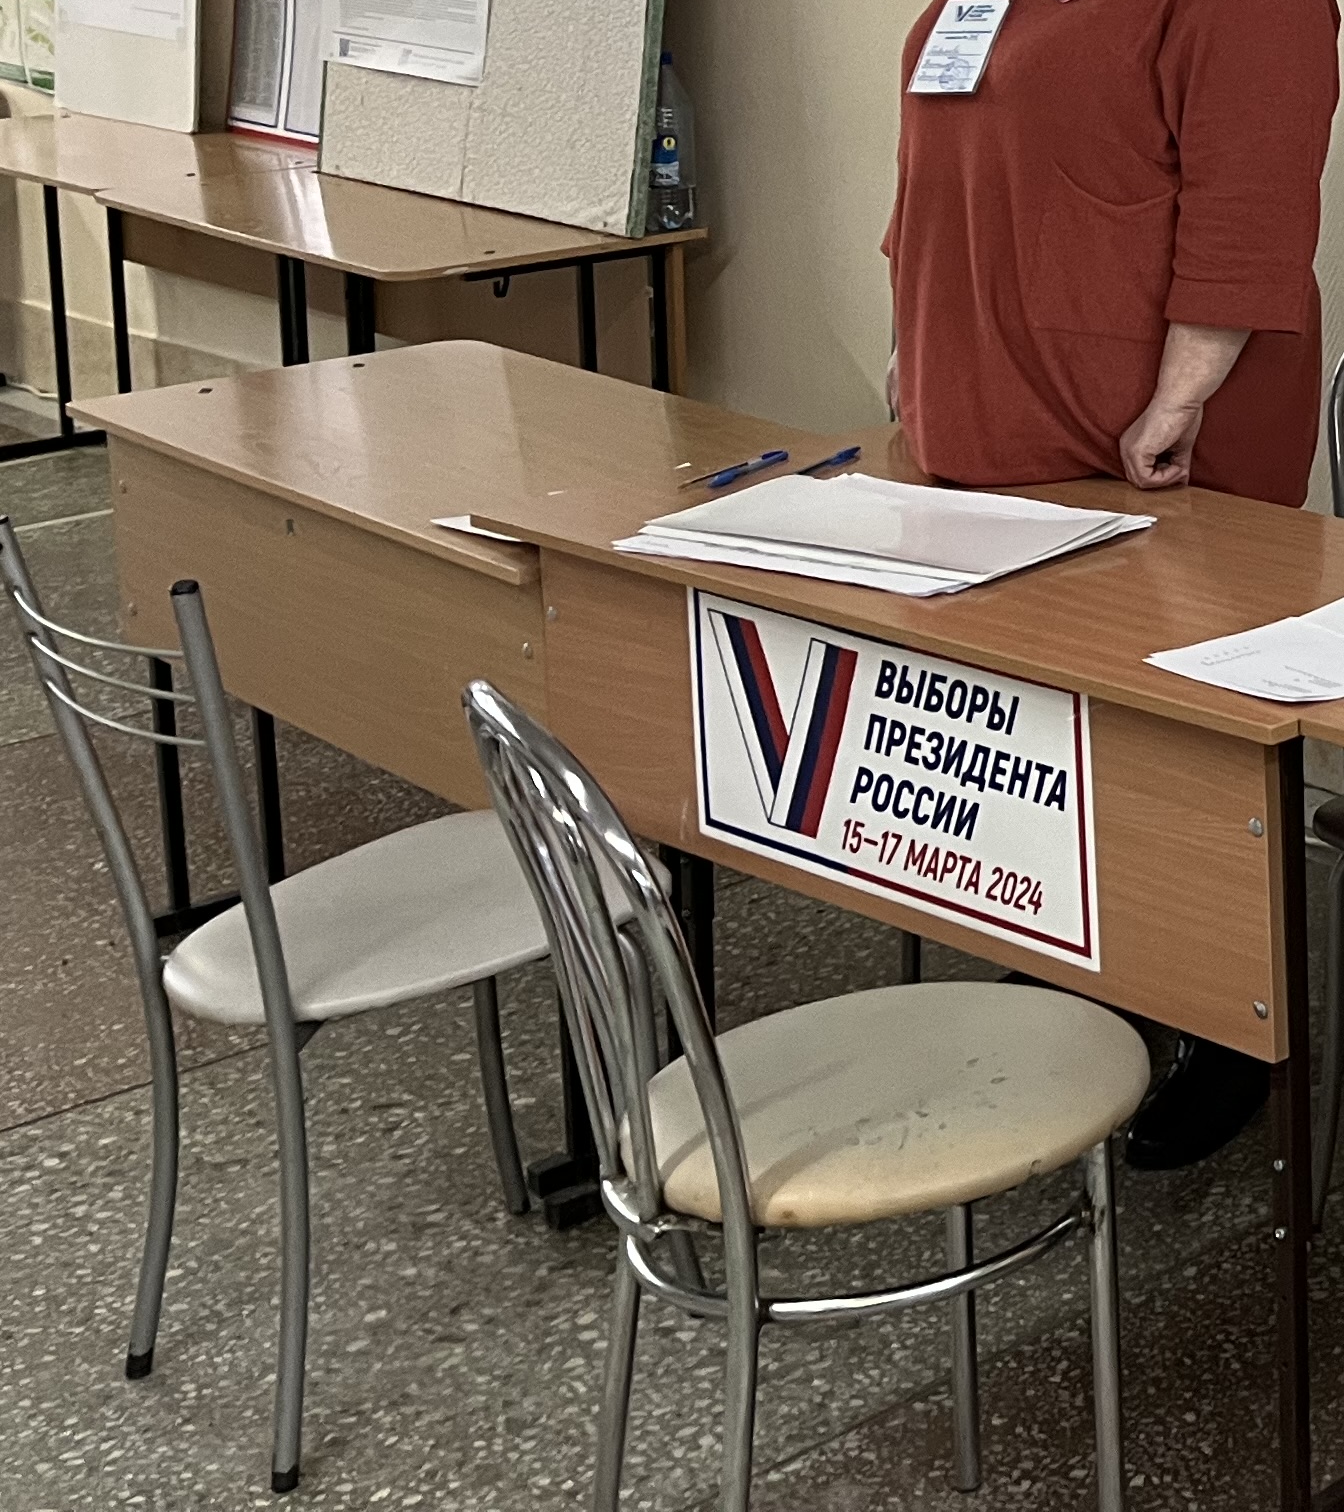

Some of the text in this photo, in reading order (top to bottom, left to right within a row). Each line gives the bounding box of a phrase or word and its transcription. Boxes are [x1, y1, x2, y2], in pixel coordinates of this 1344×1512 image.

[875, 659, 1020, 736] ВЫБОРЫ
[863, 714, 1068, 811] ПРЕЗИДЕНТА
[849, 767, 980, 840] РОССИИ
[903, 838, 982, 895] МАРТА
[985, 868, 1043, 915] 2024
